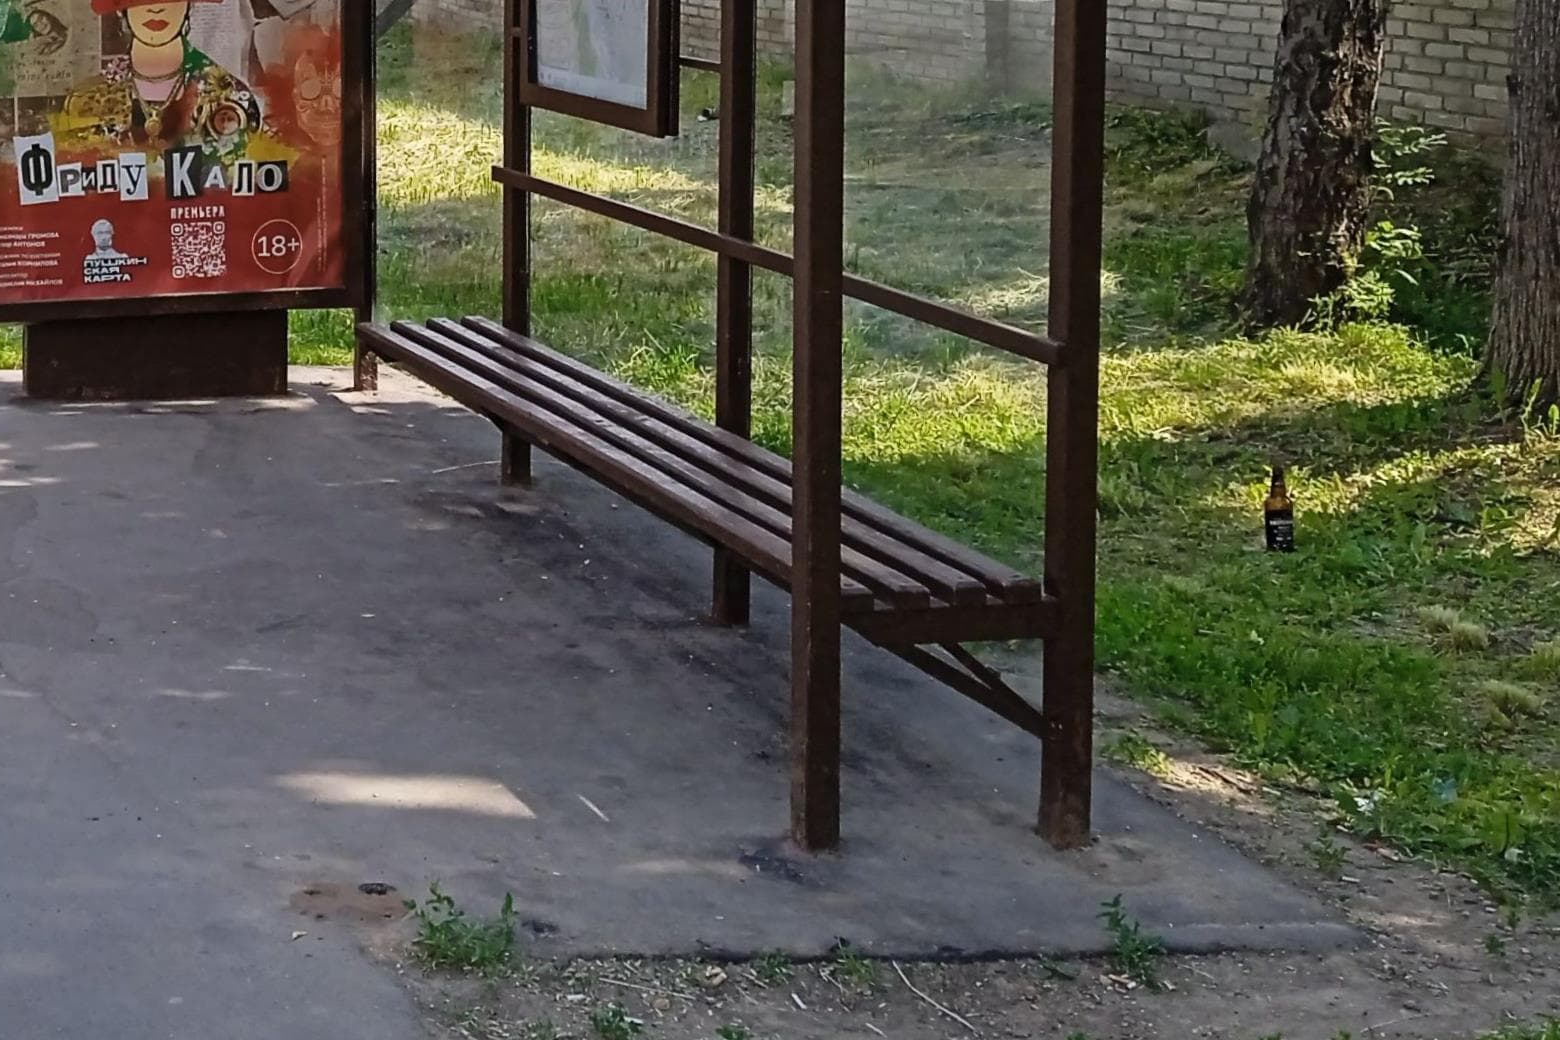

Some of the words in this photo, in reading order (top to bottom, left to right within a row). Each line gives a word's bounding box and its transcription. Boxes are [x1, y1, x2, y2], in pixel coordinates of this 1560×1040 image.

[170, 205, 225, 220] ПРЕМЬЕРА
[256, 233, 300, 258] 18+
[83, 257, 147, 268] ПУШКИН
[83, 266, 120, 275] СКАЯ
[84, 273, 131, 284] КАРТА
